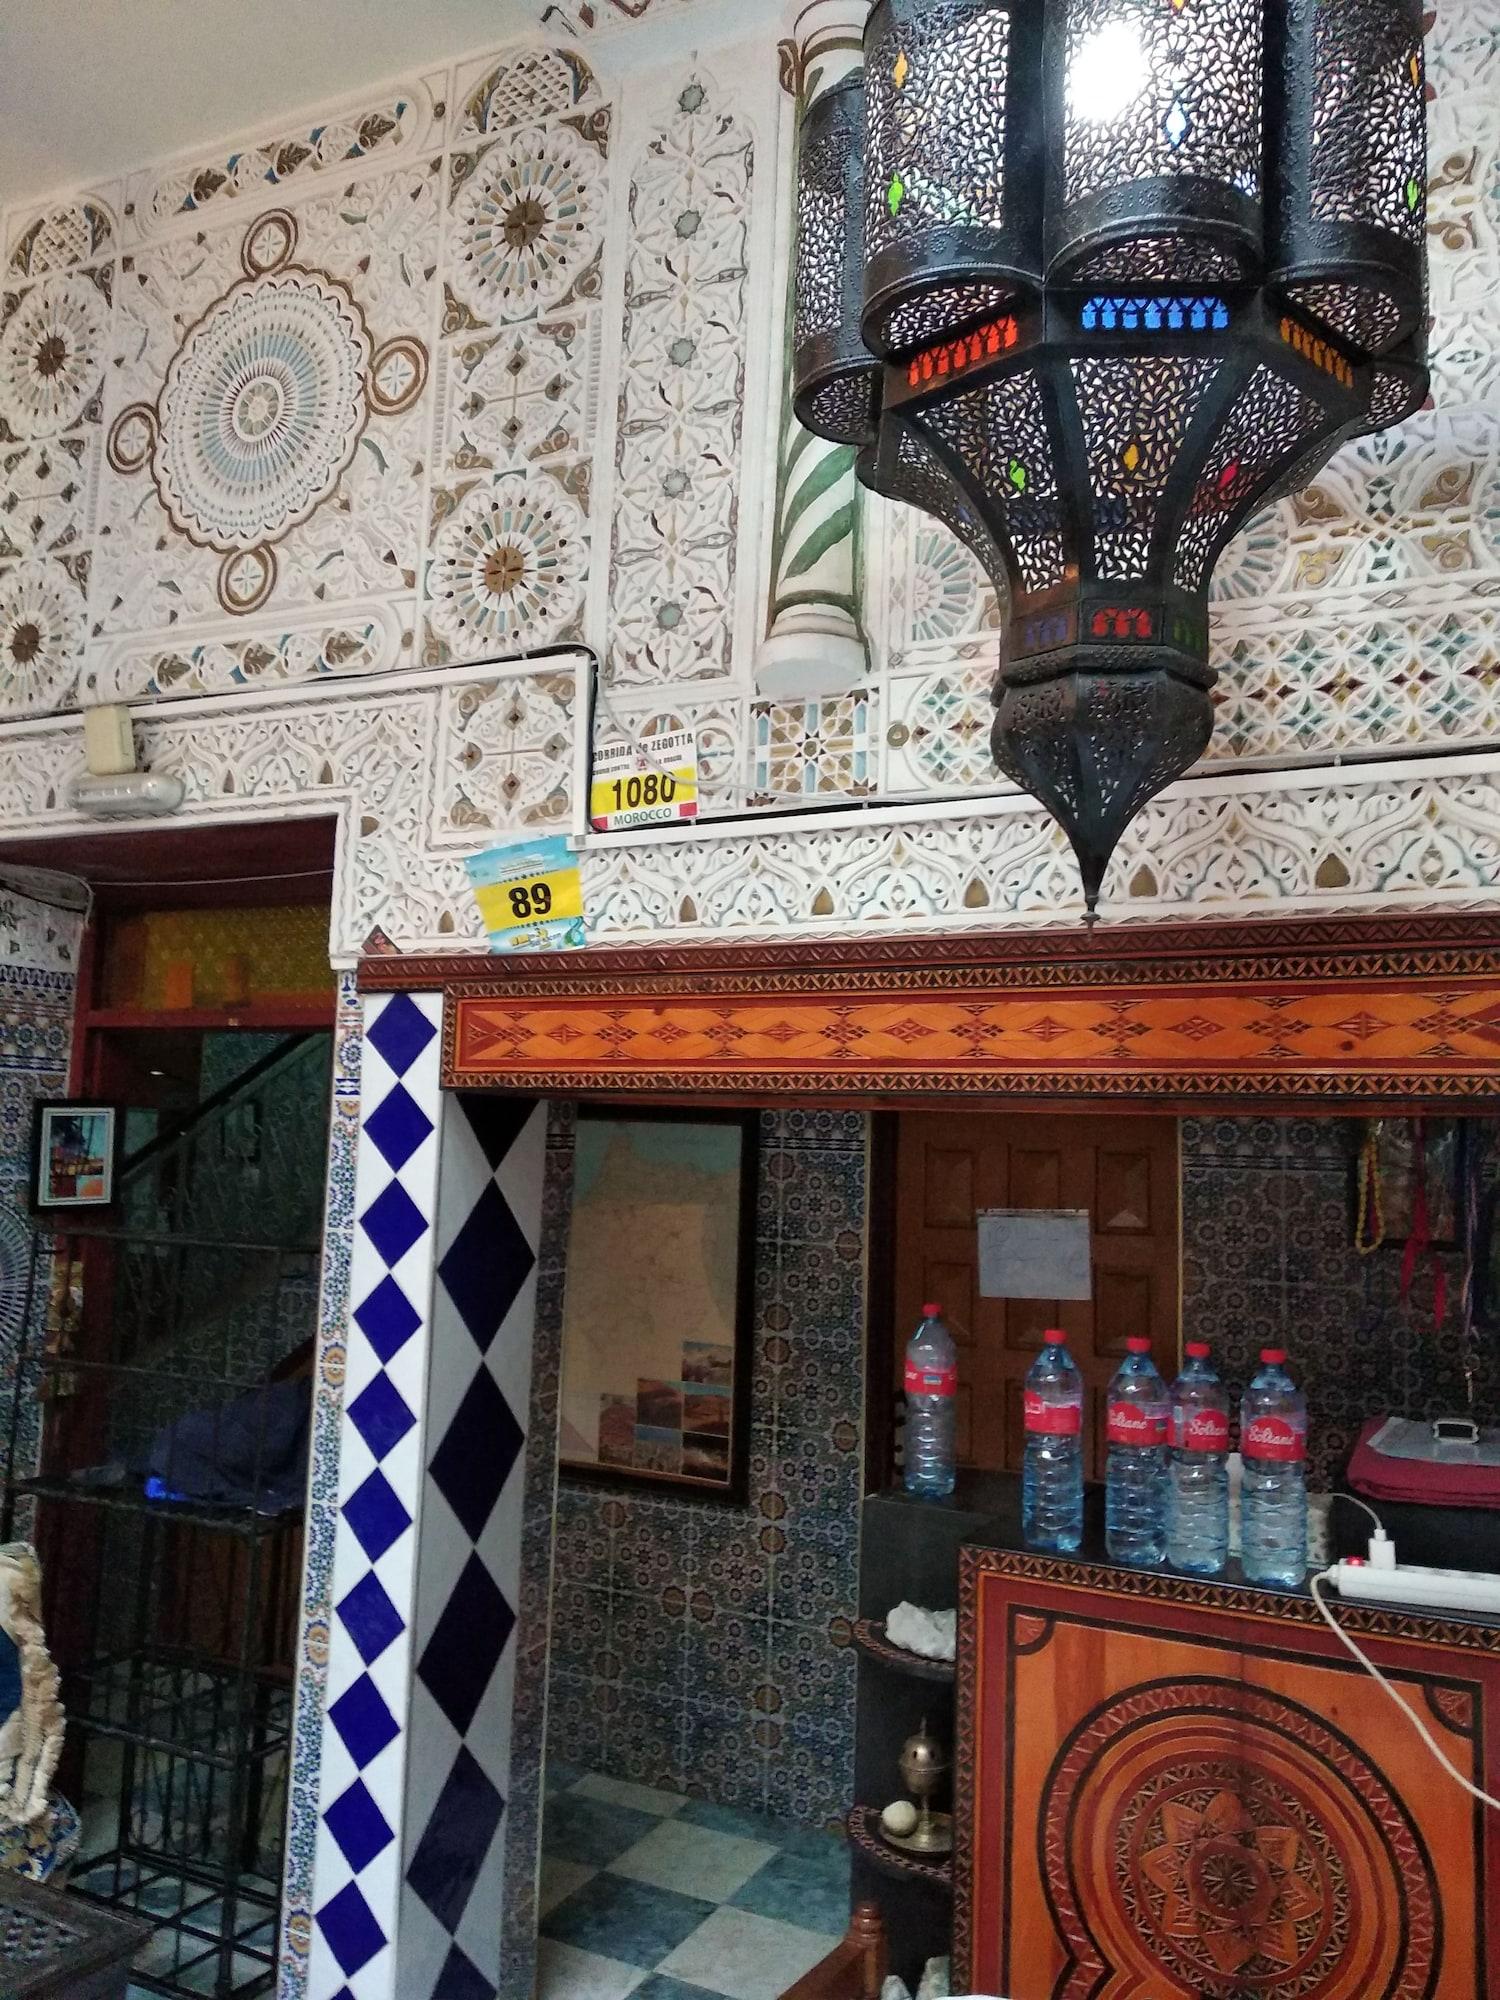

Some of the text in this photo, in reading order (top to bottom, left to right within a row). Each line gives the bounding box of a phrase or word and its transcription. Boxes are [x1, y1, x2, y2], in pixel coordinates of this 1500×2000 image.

[651, 733, 694, 752] ZEGOTTA
[612, 771, 676, 811] 1080
[614, 807, 672, 826] MOROCCO
[508, 882, 552, 919] 89
